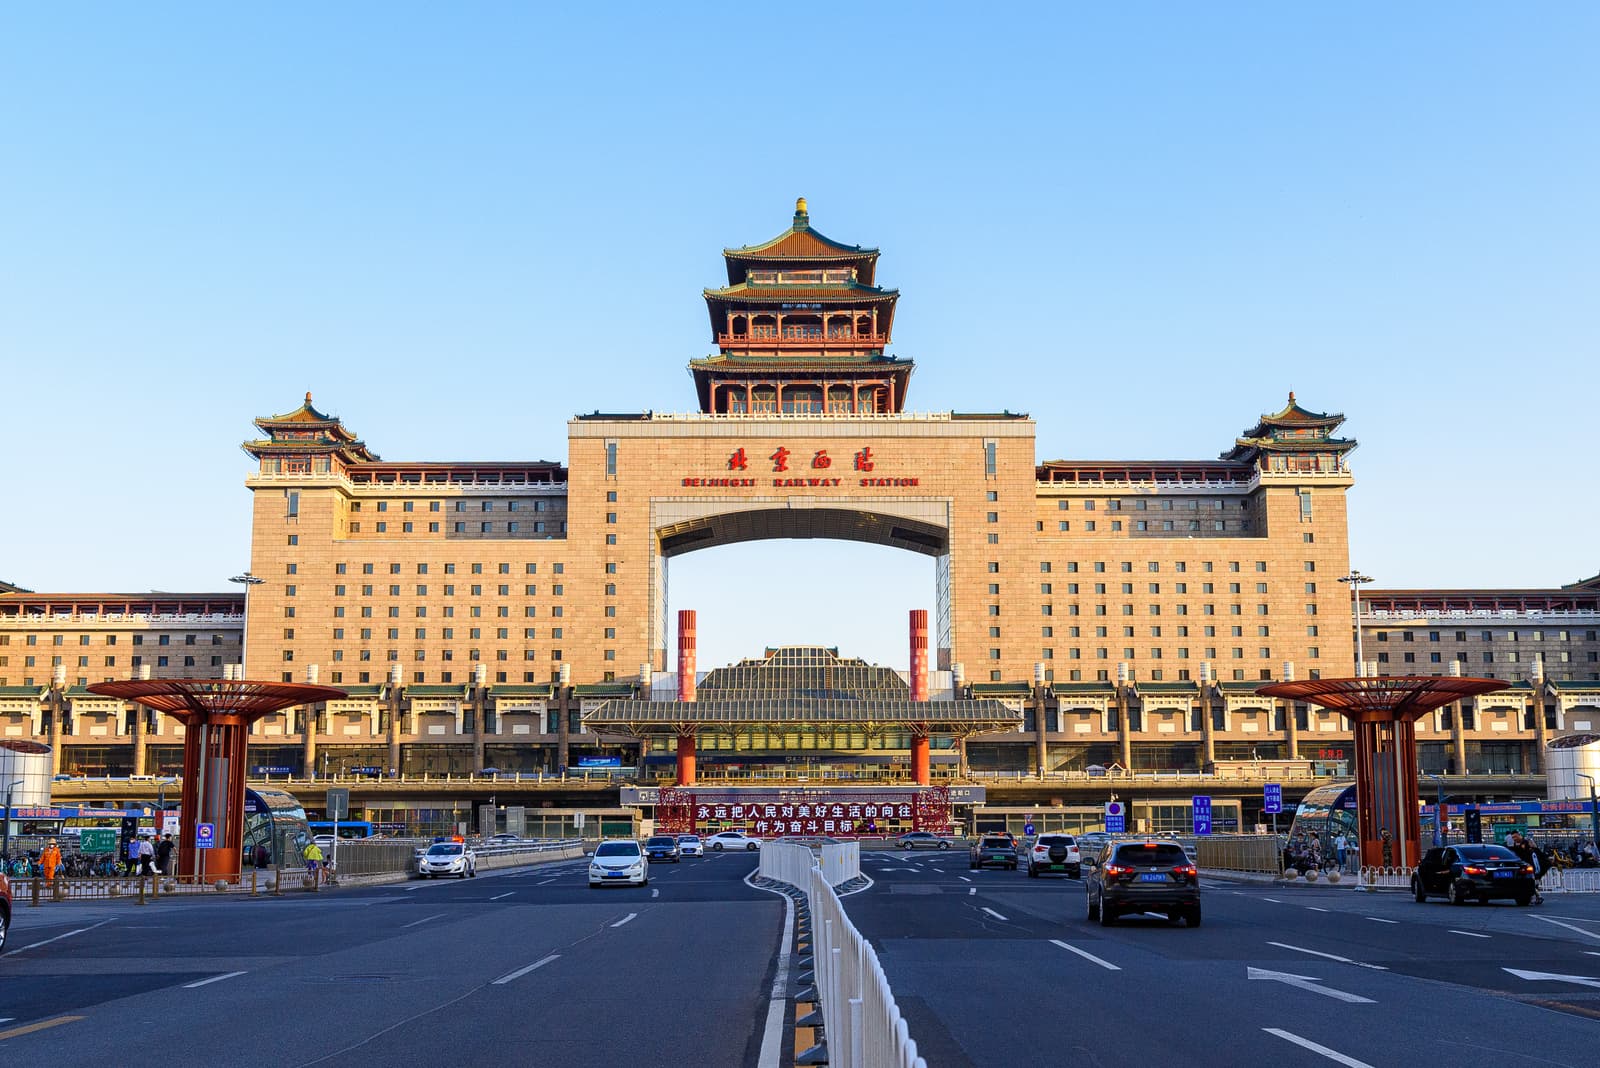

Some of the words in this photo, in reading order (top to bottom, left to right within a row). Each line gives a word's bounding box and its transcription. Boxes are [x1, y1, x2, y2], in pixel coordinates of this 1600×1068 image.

[728, 446, 875, 472] 北京西站
[682, 478, 755, 487] BEIJINGXI
[773, 478, 841, 487] RAILWAY
[859, 478, 919, 487] STATION
[698, 806, 911, 818] 永远把人民对美好生活的向往
[756, 821, 853, 833] 作为奋斗目标
